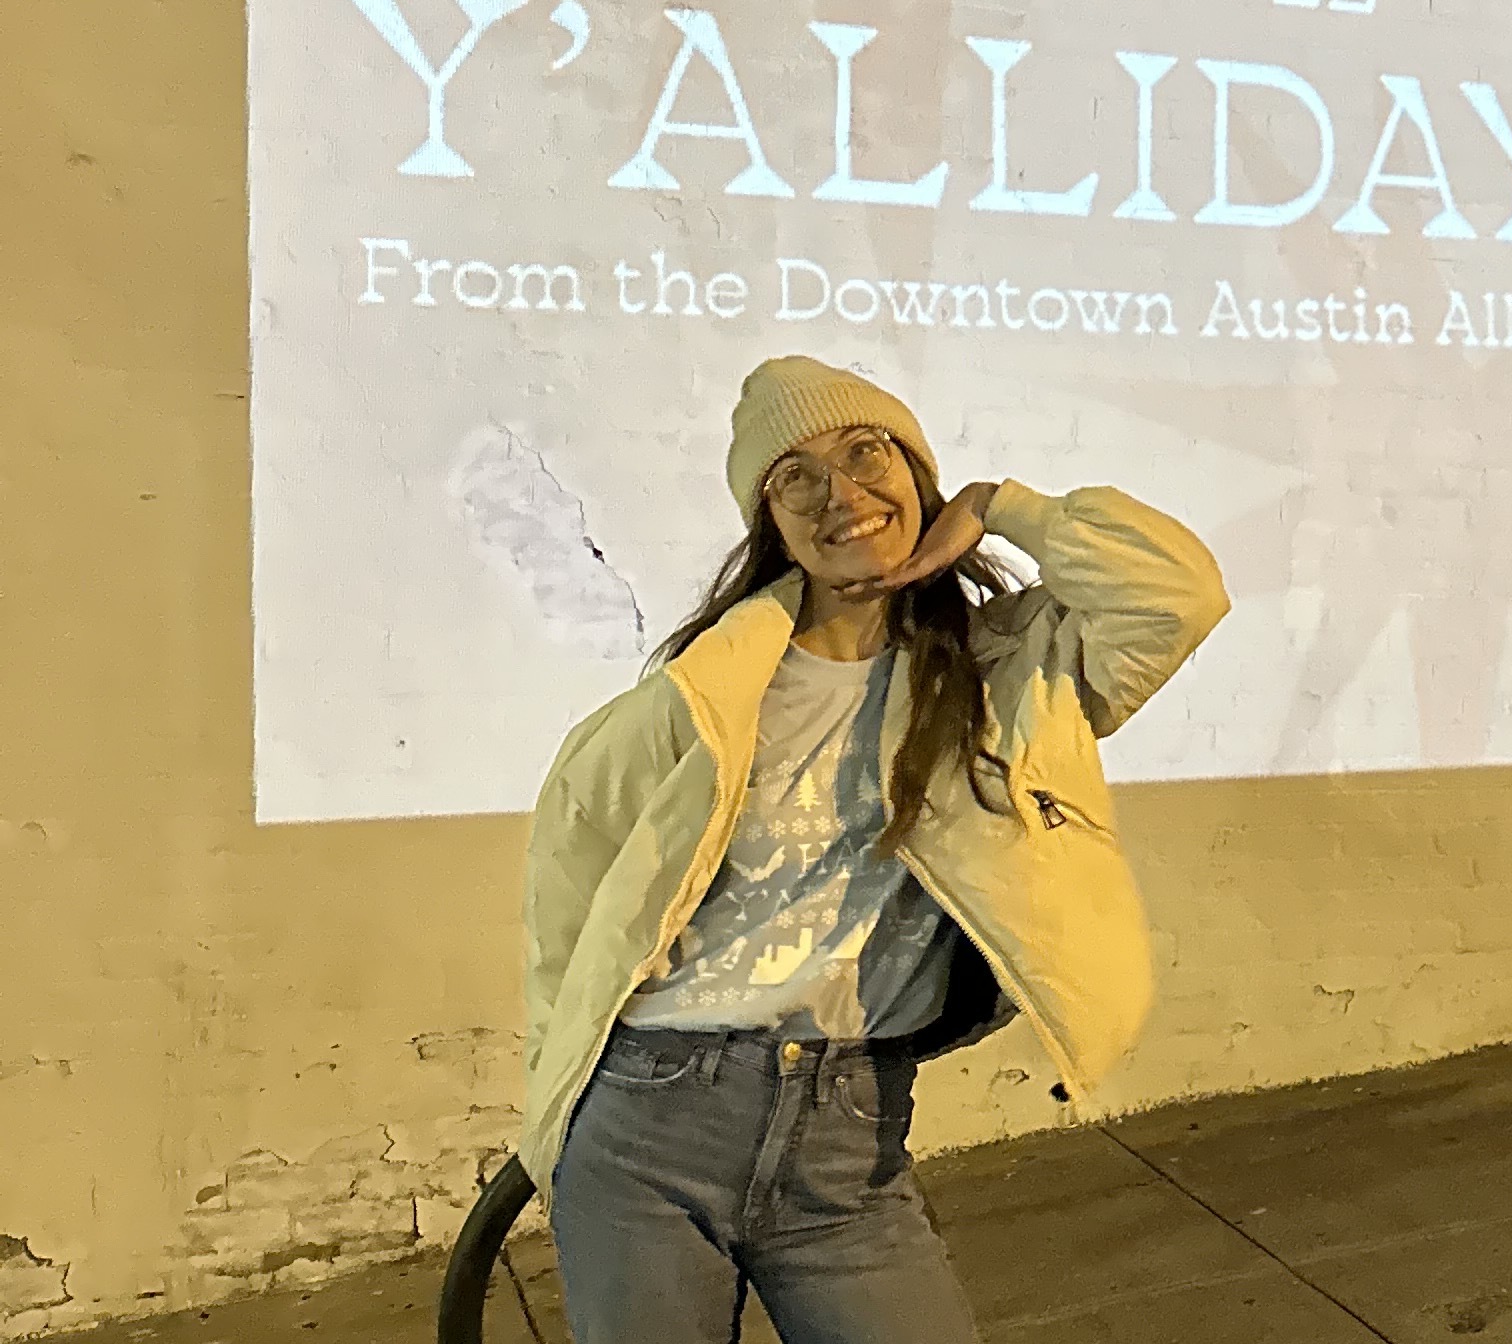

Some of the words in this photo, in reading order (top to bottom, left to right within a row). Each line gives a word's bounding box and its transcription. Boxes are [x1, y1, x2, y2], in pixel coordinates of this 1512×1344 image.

[357, 236, 587, 313] From
[612, 250, 750, 319] the
[773, 256, 1180, 338] Downtown
[1199, 278, 1416, 345] Austin
